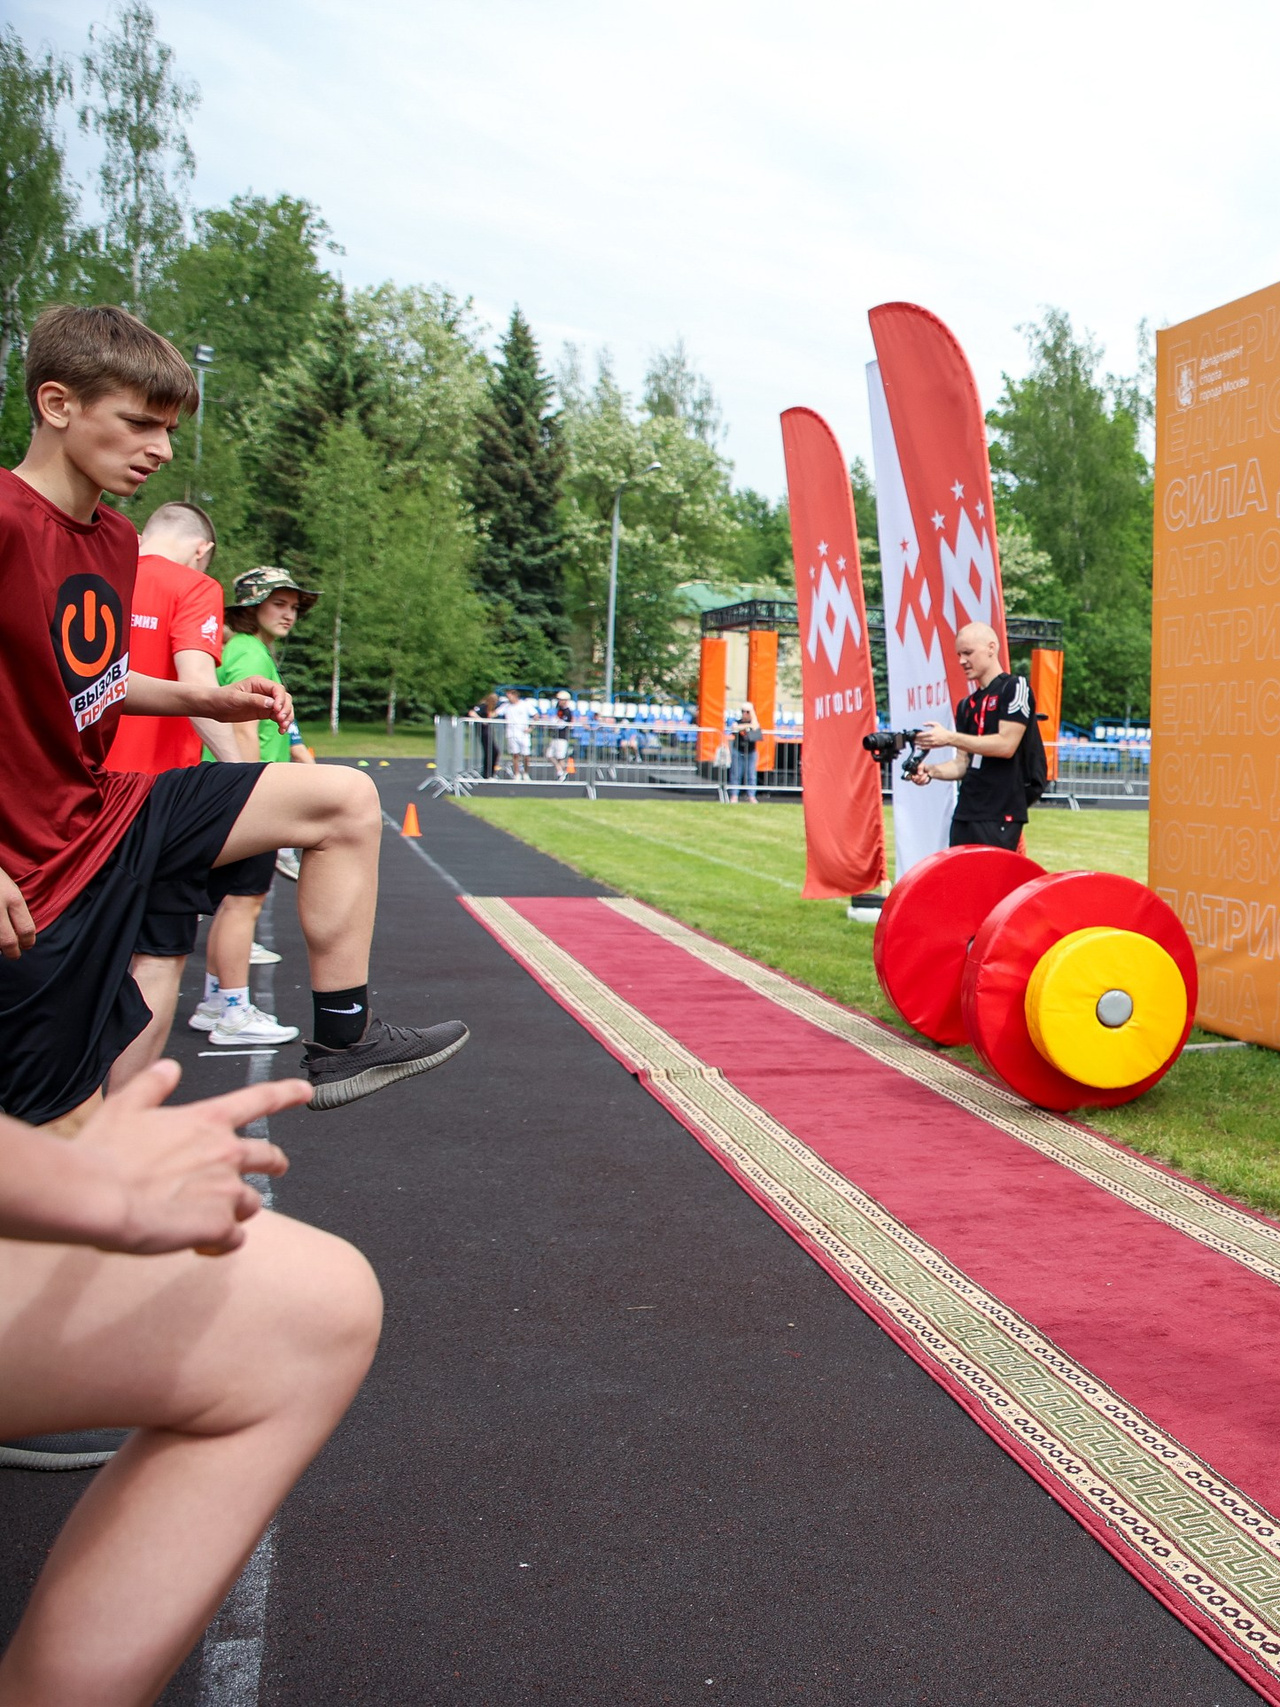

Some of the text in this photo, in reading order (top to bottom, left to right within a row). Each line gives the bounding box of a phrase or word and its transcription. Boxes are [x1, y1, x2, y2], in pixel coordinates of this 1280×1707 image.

[1163, 457, 1268, 532] СИЛА
[74, 663, 122, 713] ВЫЗОВ
[80, 677, 129, 728] ПРИНЯ
[814, 686, 863, 721] МГФСО
[1158, 753, 1263, 811] СИЛА
